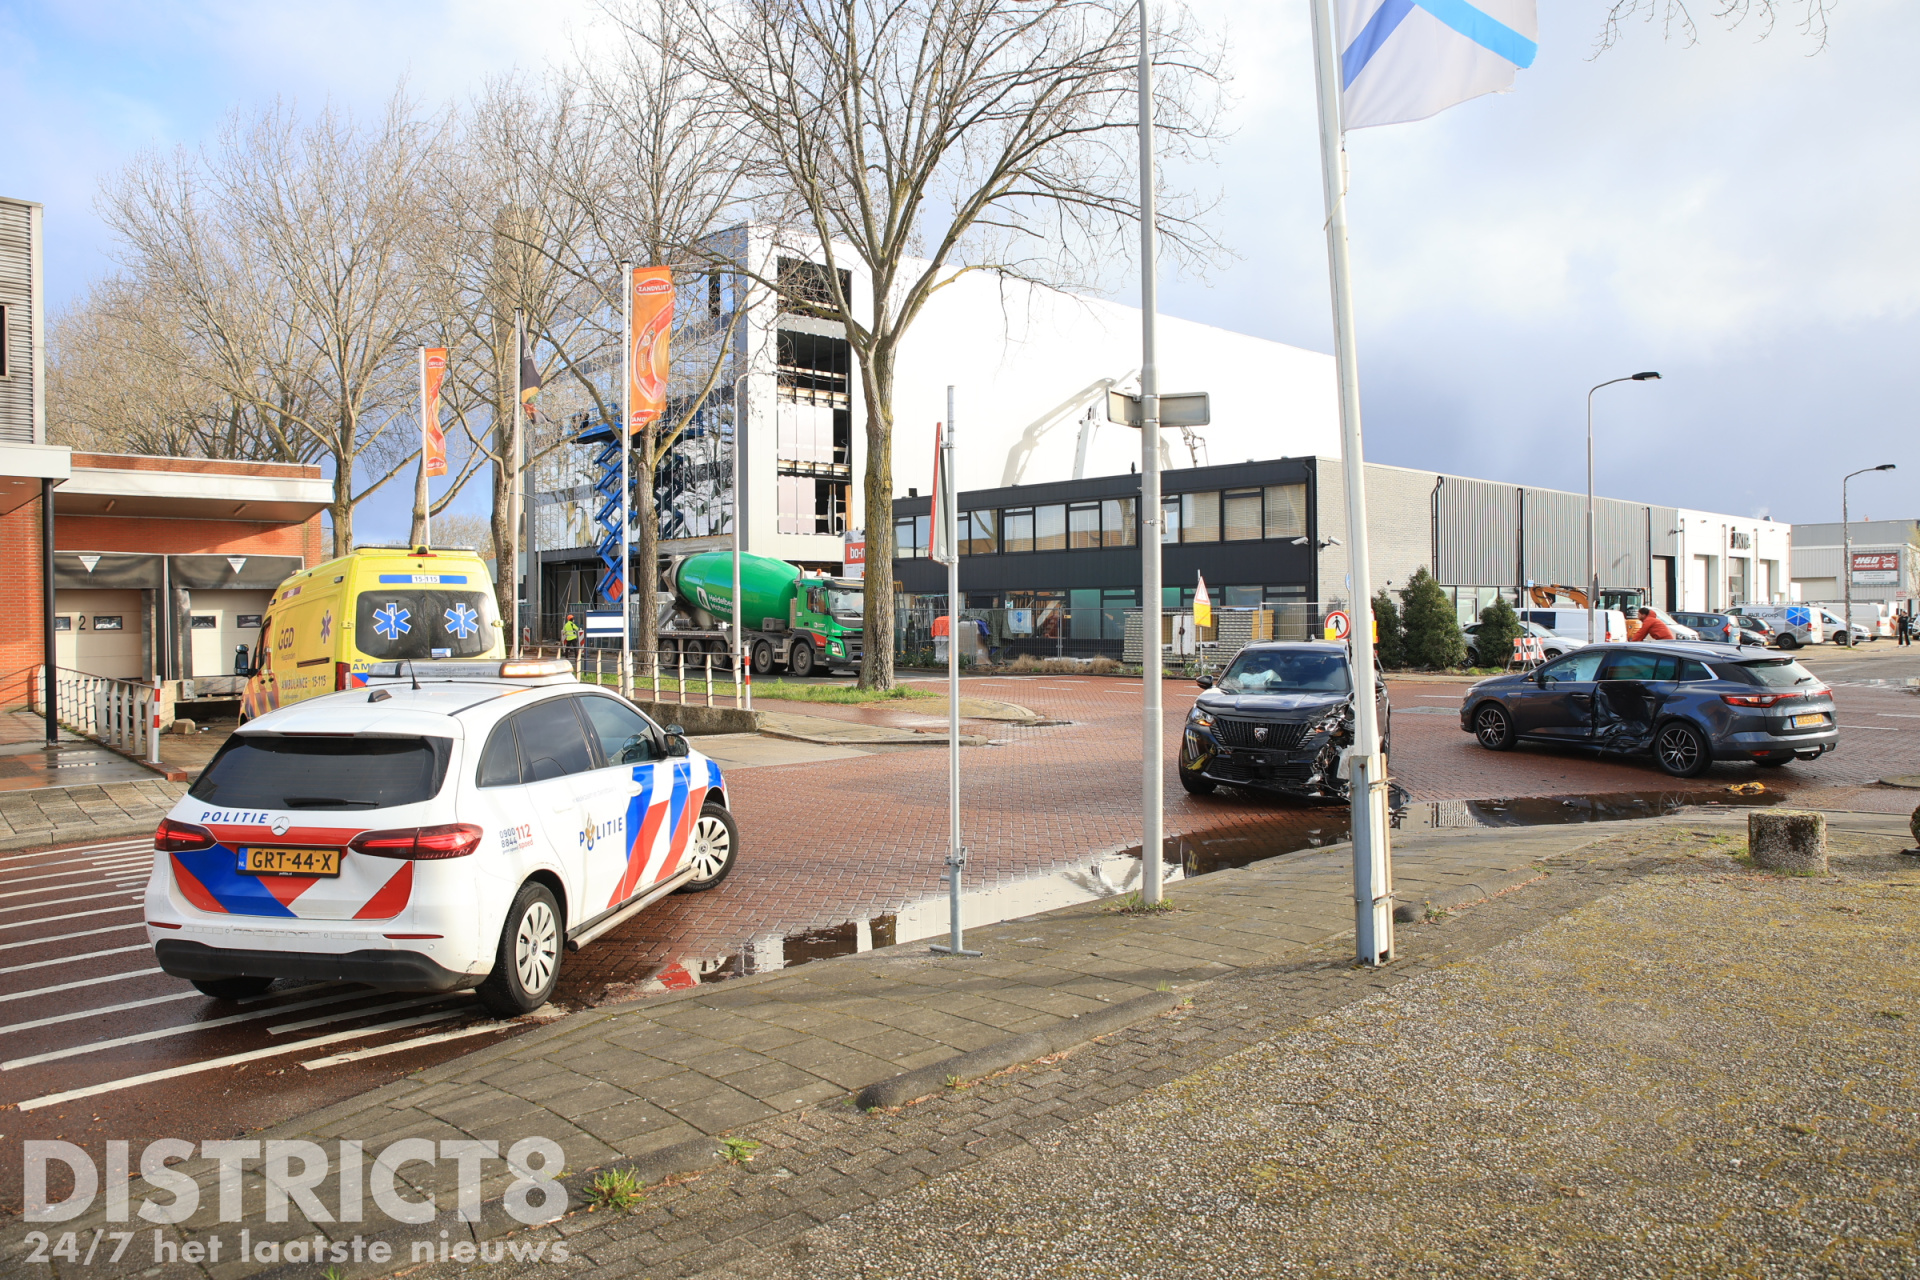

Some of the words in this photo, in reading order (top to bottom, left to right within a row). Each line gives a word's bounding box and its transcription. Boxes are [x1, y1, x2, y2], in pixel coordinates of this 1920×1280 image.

[638, 284, 670, 292] ZANDVLIET
[78, 615, 86, 630] 2
[278, 627, 295, 650] GGD
[201, 811, 269, 824] POLITIE
[499, 827, 516, 839] 0900
[516, 823, 532, 840] 112
[579, 817, 623, 851] POLITIE
[501, 836, 518, 848] 8844
[252, 851, 332, 871] GRT-44-X
